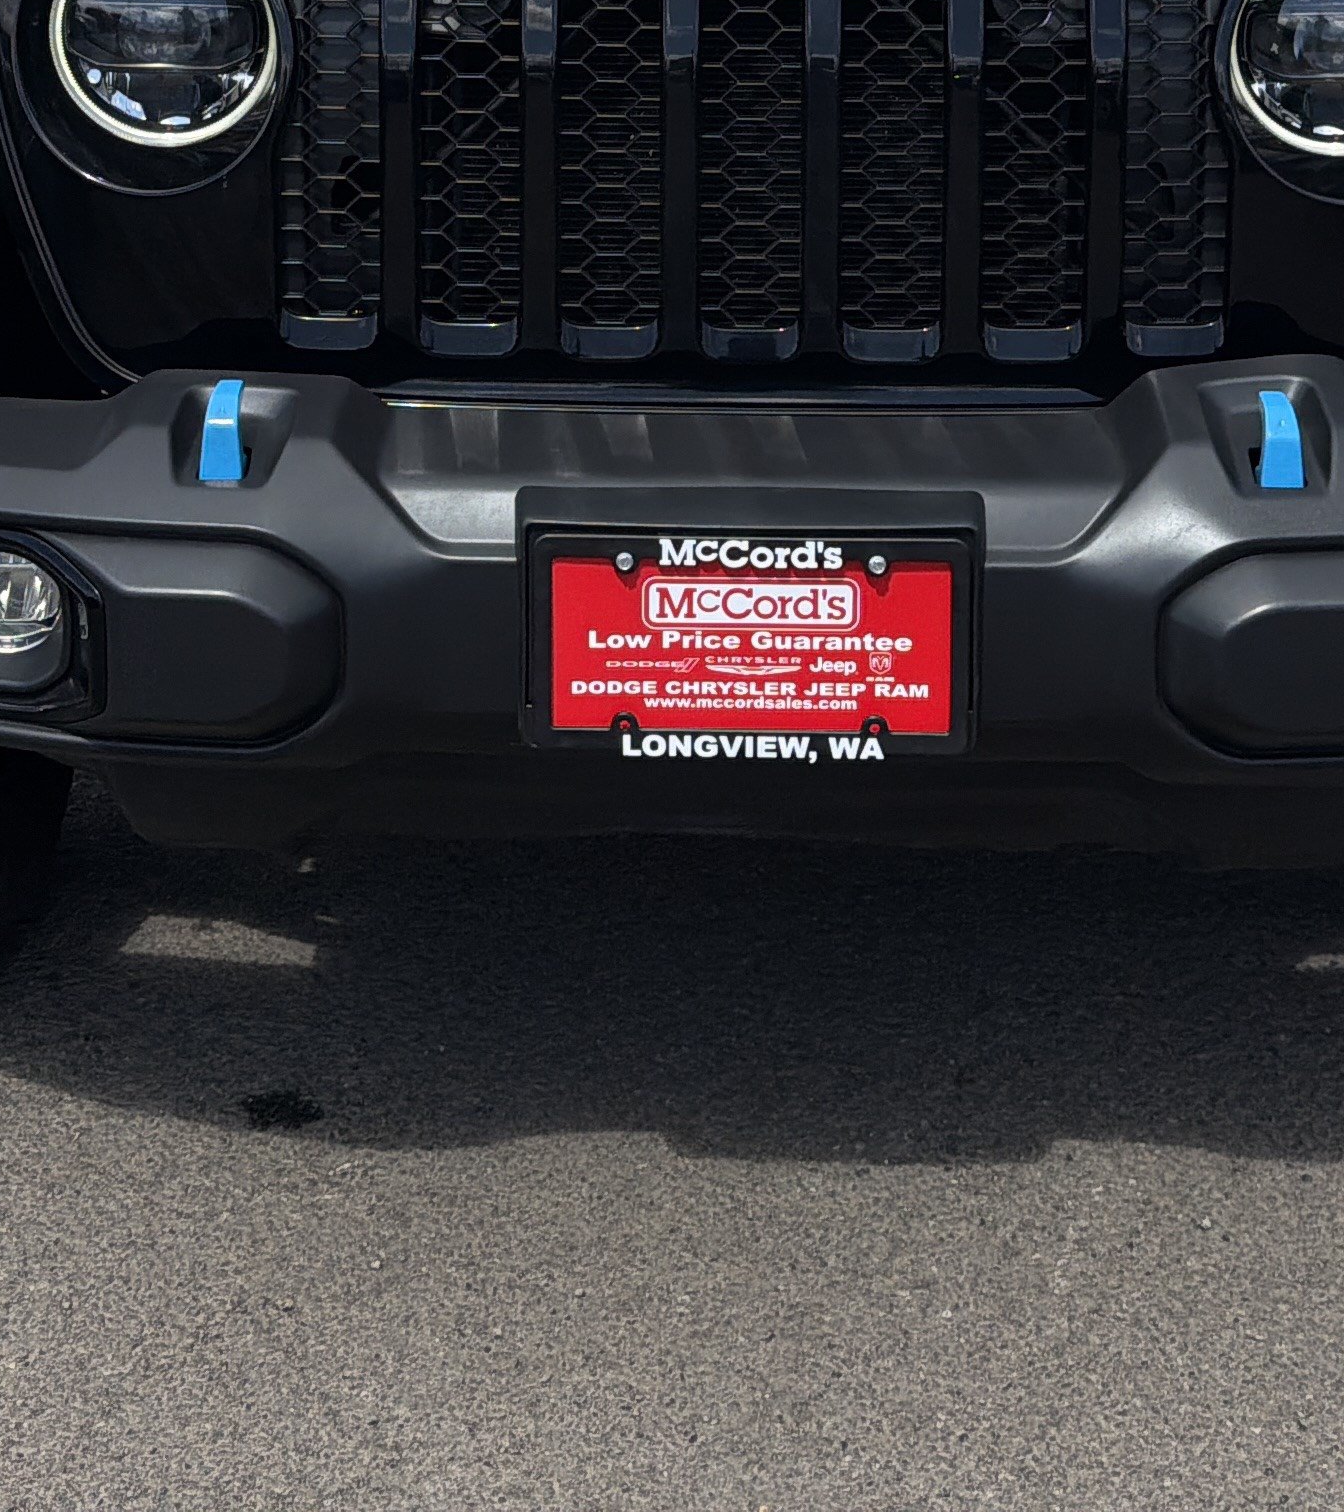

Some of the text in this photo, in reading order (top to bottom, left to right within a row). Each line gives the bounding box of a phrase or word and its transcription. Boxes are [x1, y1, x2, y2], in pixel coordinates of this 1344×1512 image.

[659, 538, 843, 570] McCord's
[655, 587, 847, 621] McCord's
[588, 630, 913, 652] Low Price Guarantee
[705, 655, 802, 664] CHRYSLER
[809, 656, 857, 676] Jeep
[571, 680, 929, 698] DODGE CHRYSLER JEEP RAM
[643, 696, 858, 710] www.mccordsales.com
[622, 734, 885, 764] LONGVIEW, WA
